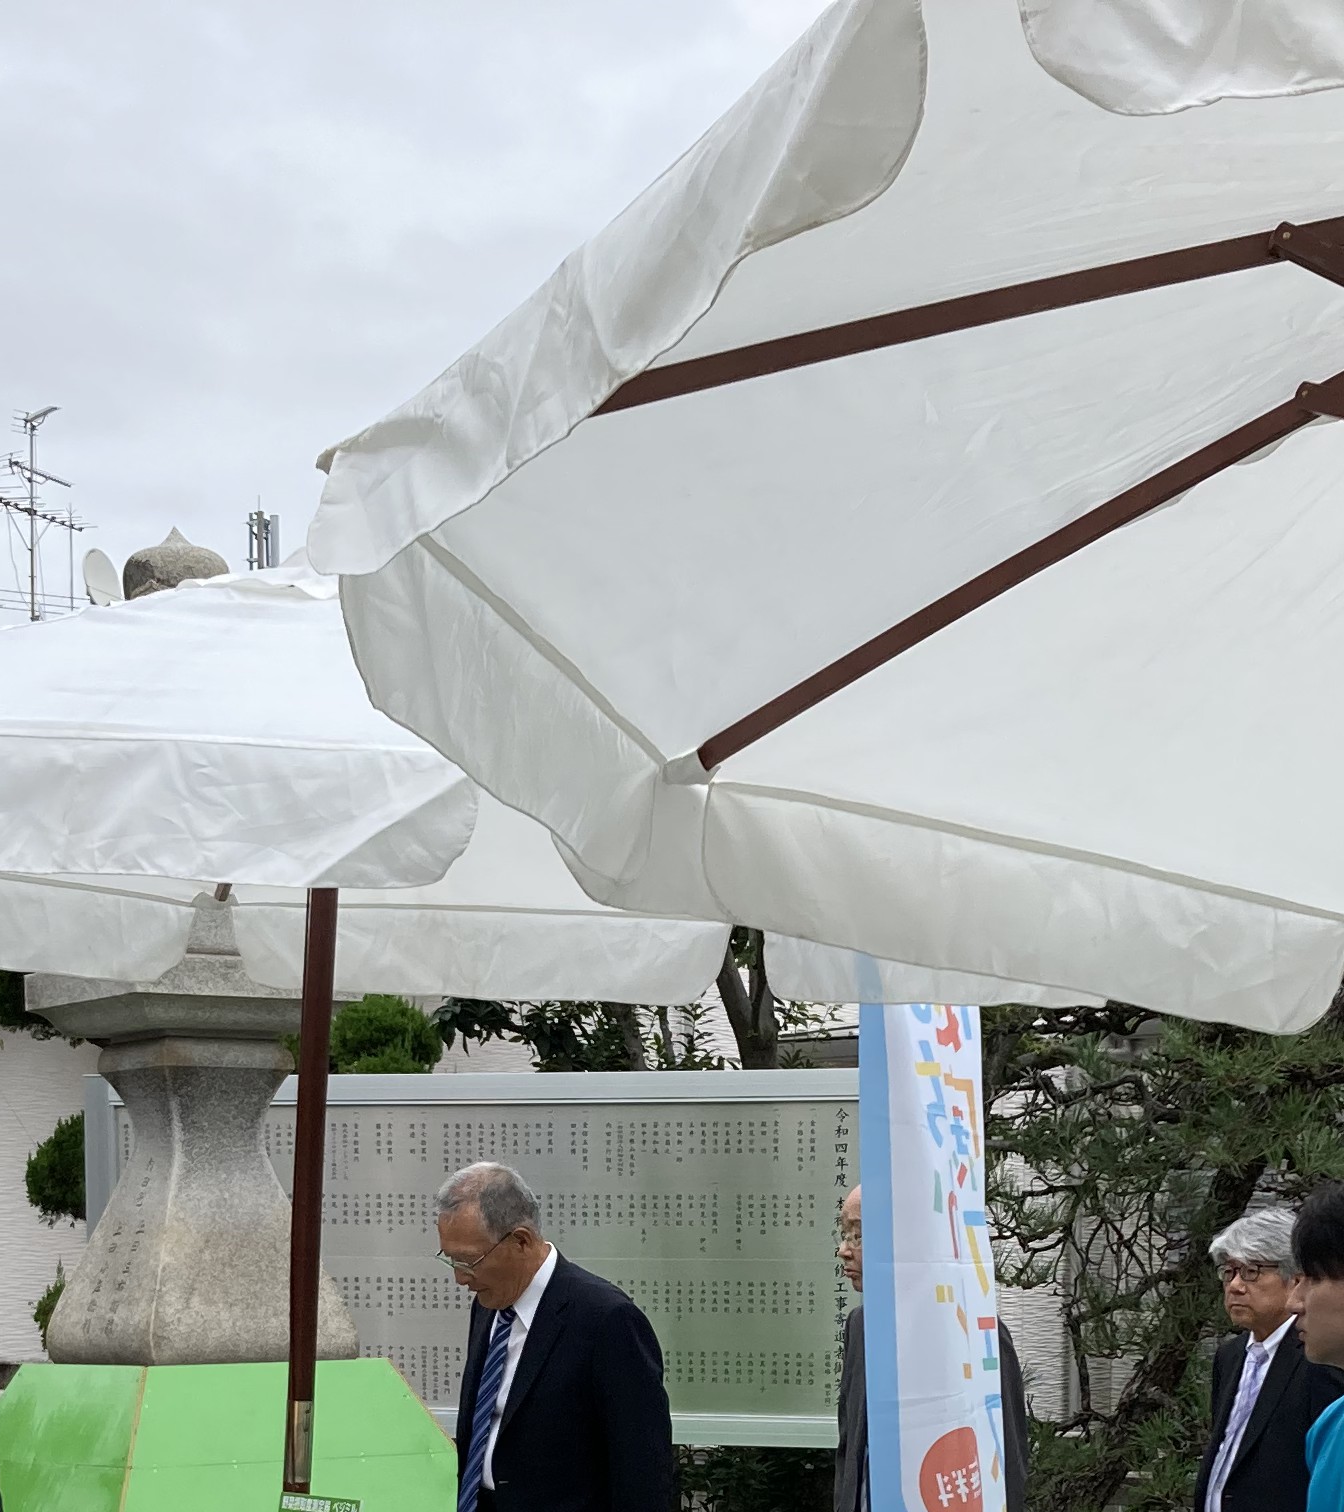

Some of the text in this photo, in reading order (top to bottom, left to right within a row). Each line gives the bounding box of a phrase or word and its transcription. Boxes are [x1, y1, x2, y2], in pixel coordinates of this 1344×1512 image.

[833, 1107, 850, 1188] 令和四年度
